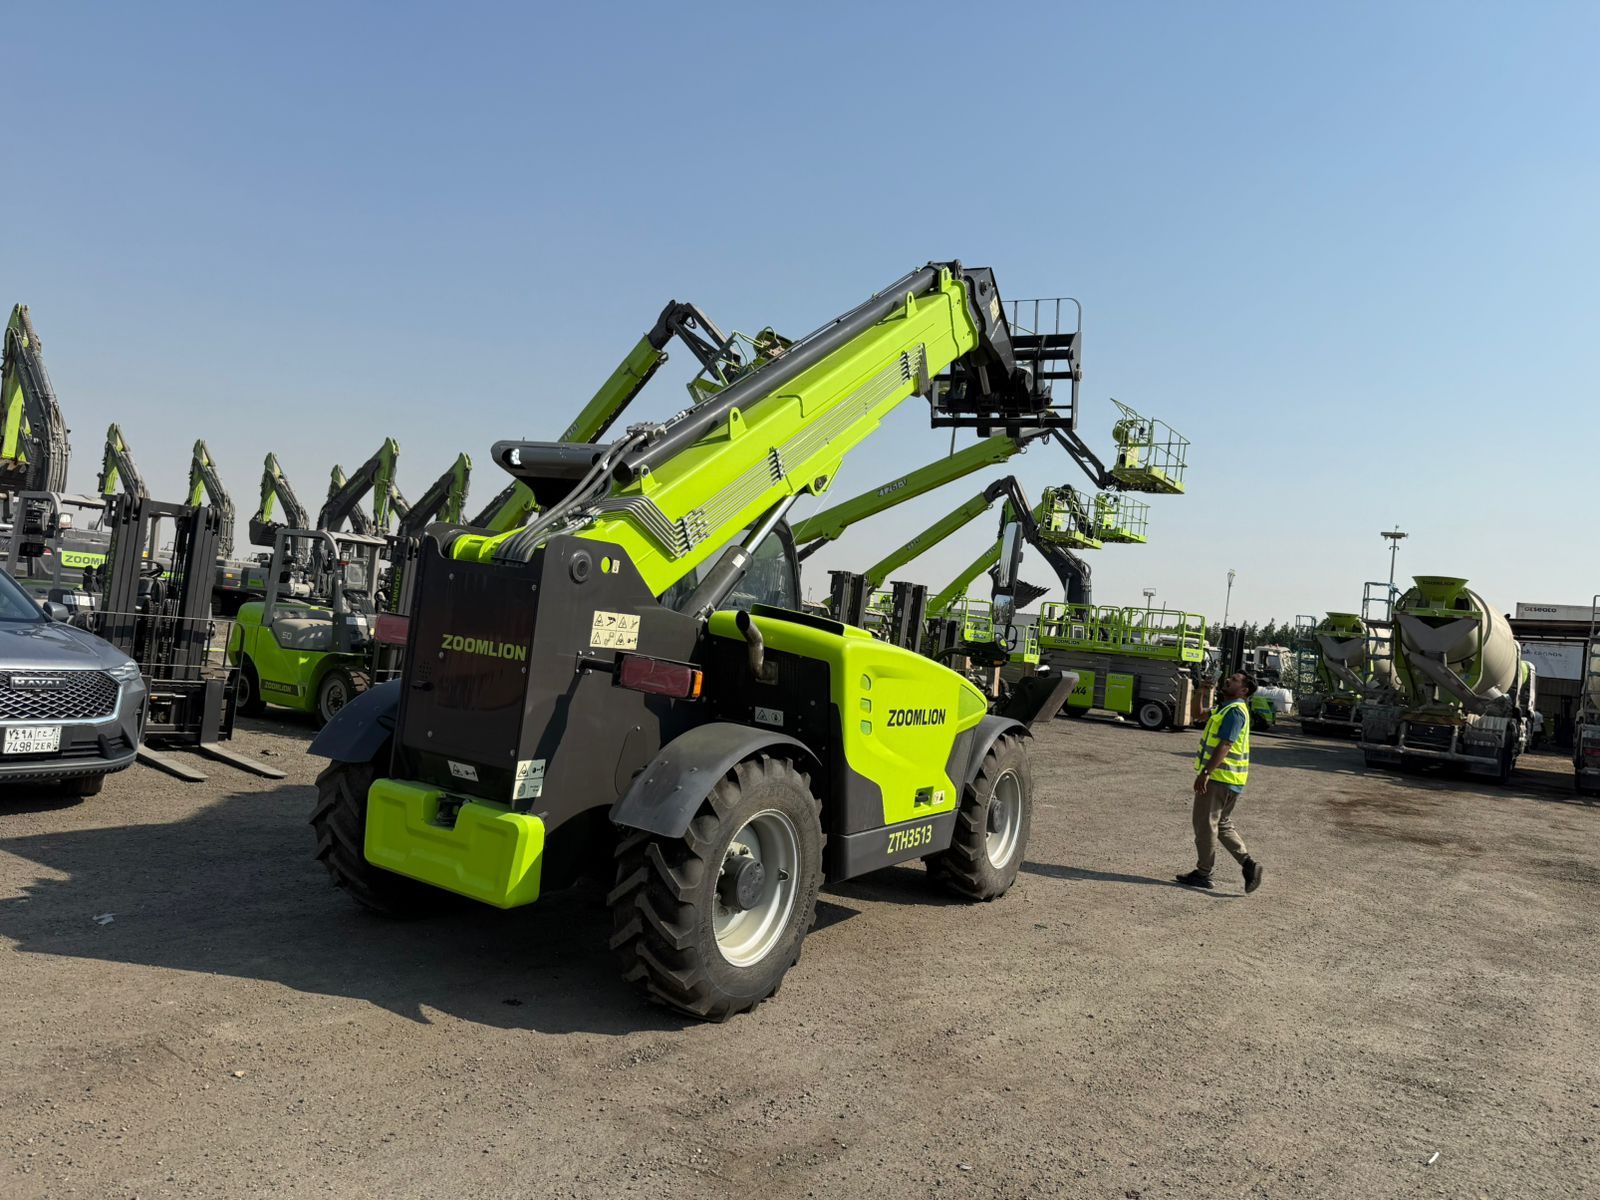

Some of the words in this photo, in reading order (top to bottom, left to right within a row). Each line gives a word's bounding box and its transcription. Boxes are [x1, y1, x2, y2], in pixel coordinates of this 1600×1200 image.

[65, 554, 104, 566] ZOOML
[441, 633, 527, 662] ZOOMLION
[887, 708, 946, 727] ZOOMLION
[6, 741, 33, 753] 7498
[34, 742, 52, 751] ZER
[887, 824, 933, 855] ZTH3513
